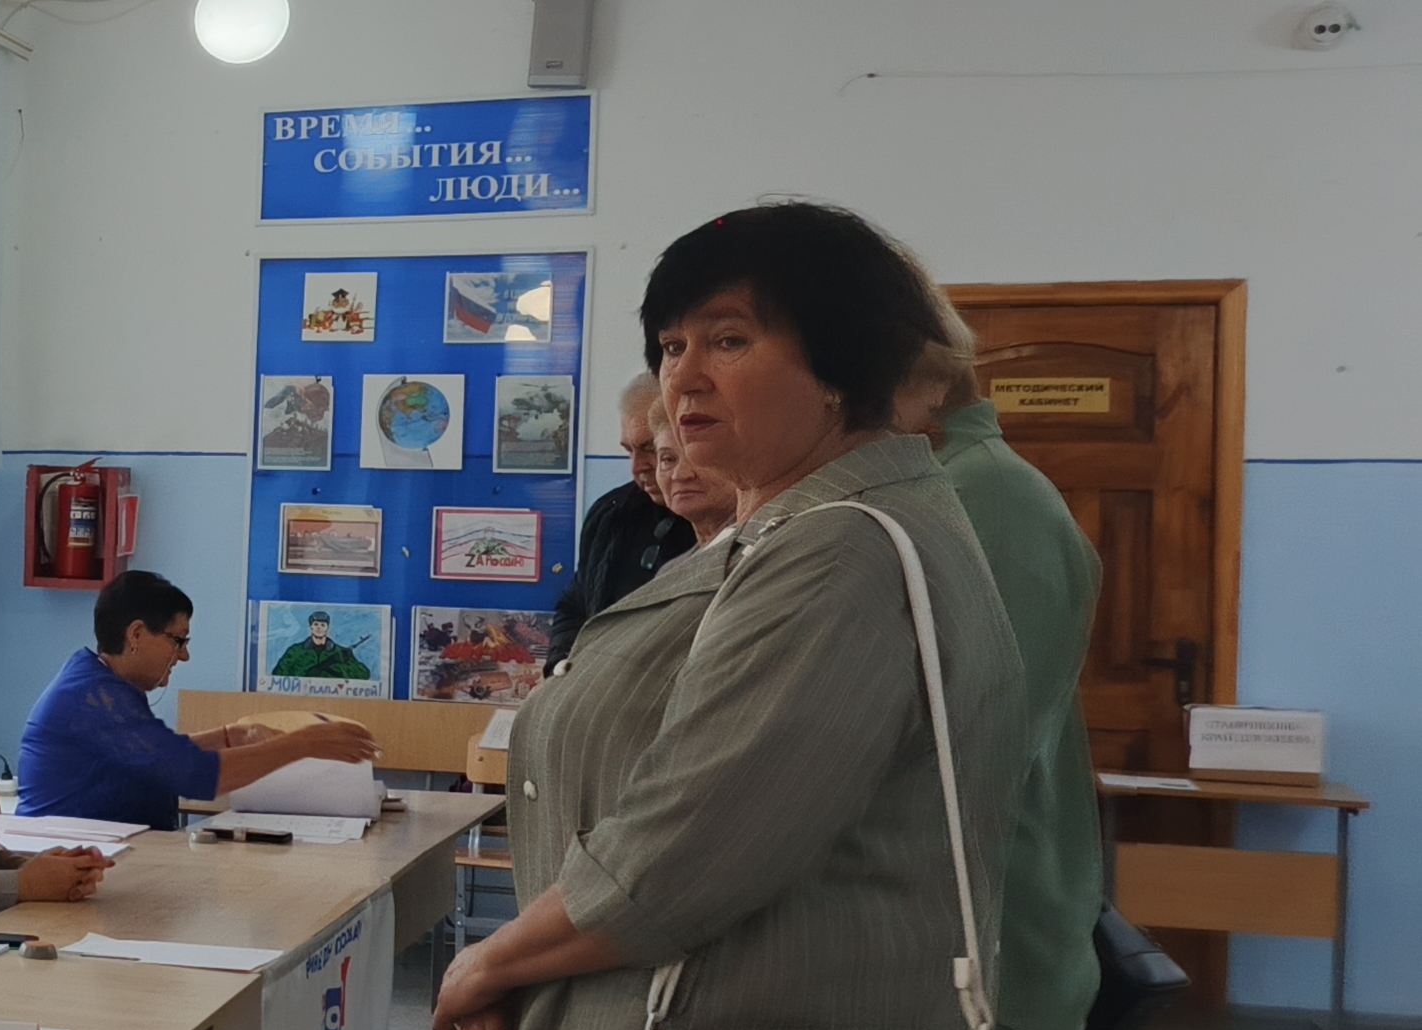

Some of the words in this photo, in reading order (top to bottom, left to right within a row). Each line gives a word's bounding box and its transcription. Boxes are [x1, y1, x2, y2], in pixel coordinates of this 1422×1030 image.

[314, 140, 532, 173] СОБЫТИЯ...
[429, 173, 580, 203] ЛЮДИ...
[994, 383, 1104, 393] МЕТОДИЧЕСКИЙ
[267, 677, 301, 692] МОЙ
